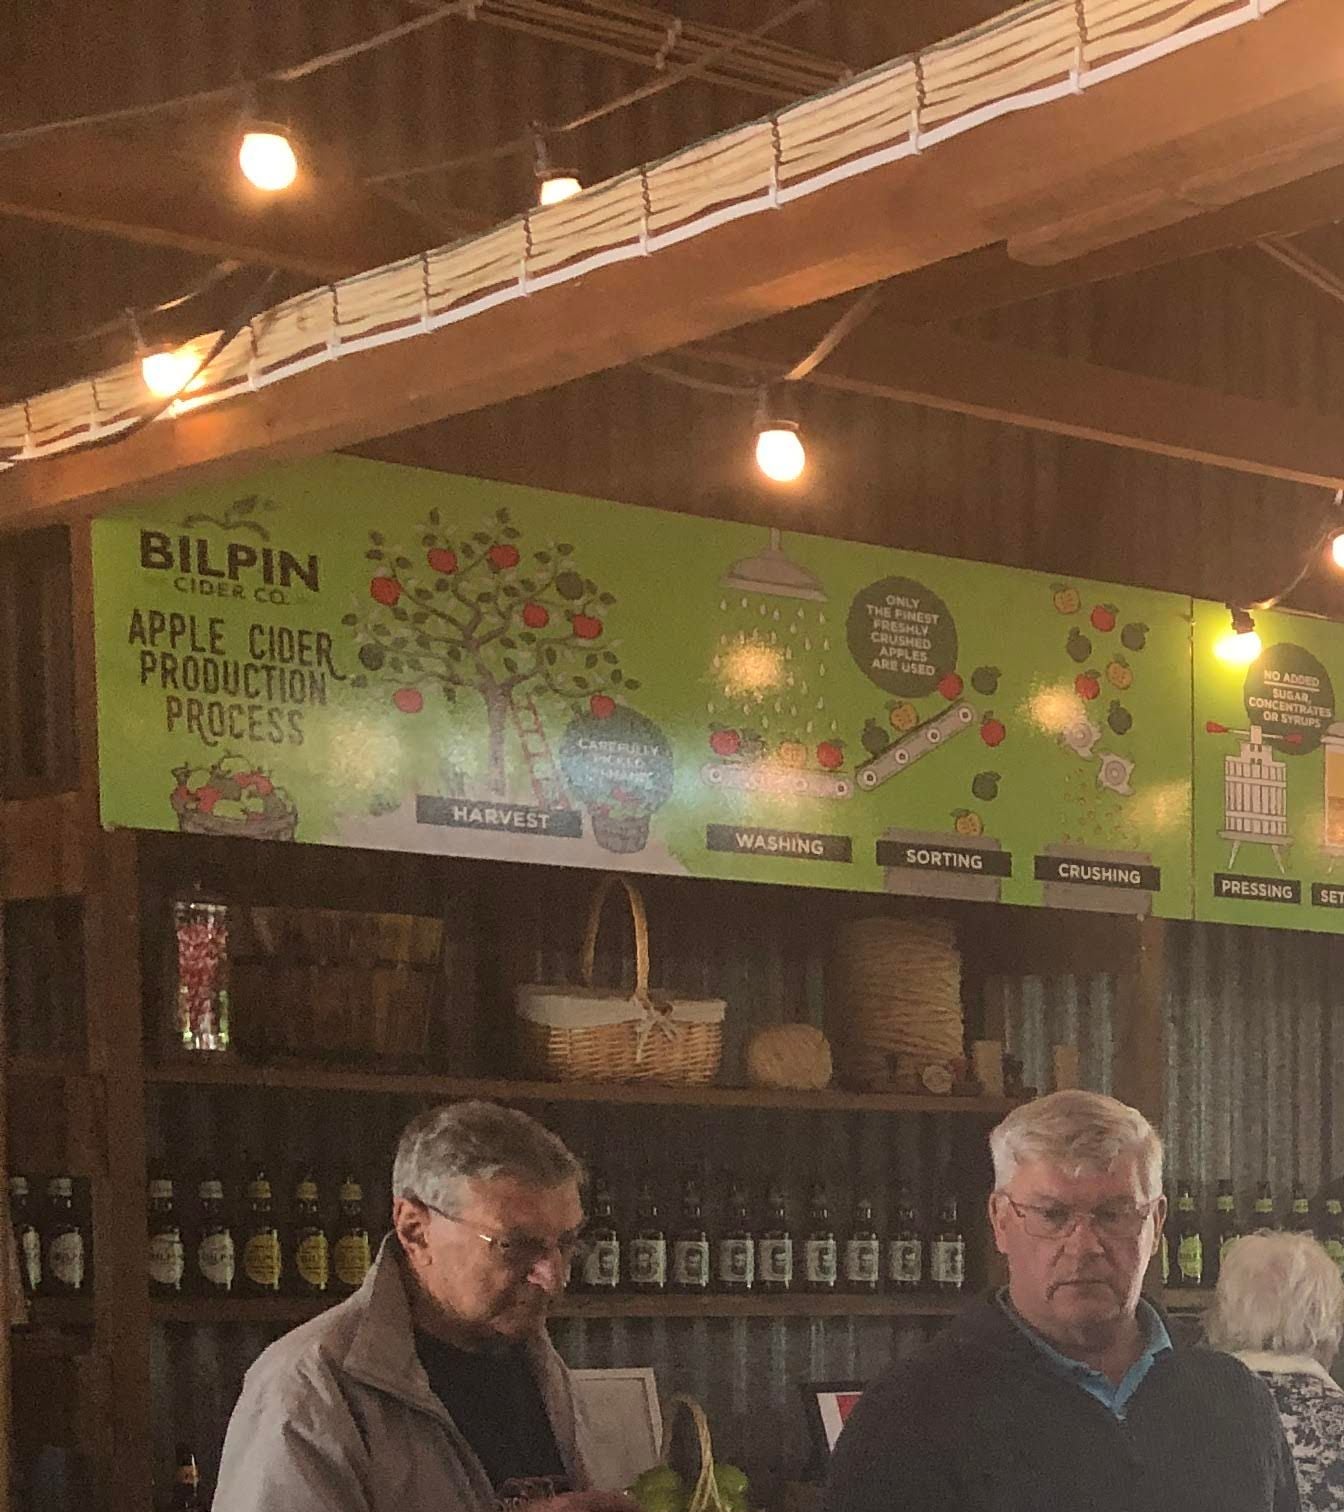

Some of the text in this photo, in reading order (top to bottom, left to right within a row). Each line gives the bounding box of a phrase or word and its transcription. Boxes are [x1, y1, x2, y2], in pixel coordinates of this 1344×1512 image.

[140, 528, 320, 593] BILPIN
[174, 575, 245, 601] CIDER
[886, 594, 920, 609] ONLY
[866, 604, 939, 624] THE FINEST
[873, 619, 929, 636] FRESHLY
[128, 609, 349, 682] APPLE CIDER
[871, 631, 932, 650] CRUSHED
[879, 646, 928, 662] APPLES
[140, 649, 328, 706] PRODUCTION
[872, 658, 935, 676] ARE USED
[1264, 670, 1320, 687] NO ADDED
[1248, 696, 1332, 718] CONCENTRATES
[166, 696, 305, 747] PROCESS
[1263, 710, 1321, 728] OR SYRUPS
[452, 805, 551, 831] HARVEST
[735, 832, 825, 856] WASHING
[906, 848, 984, 870] SORTING
[1057, 863, 1141, 885] CRUSHING
[1221, 879, 1293, 900] PRESSING
